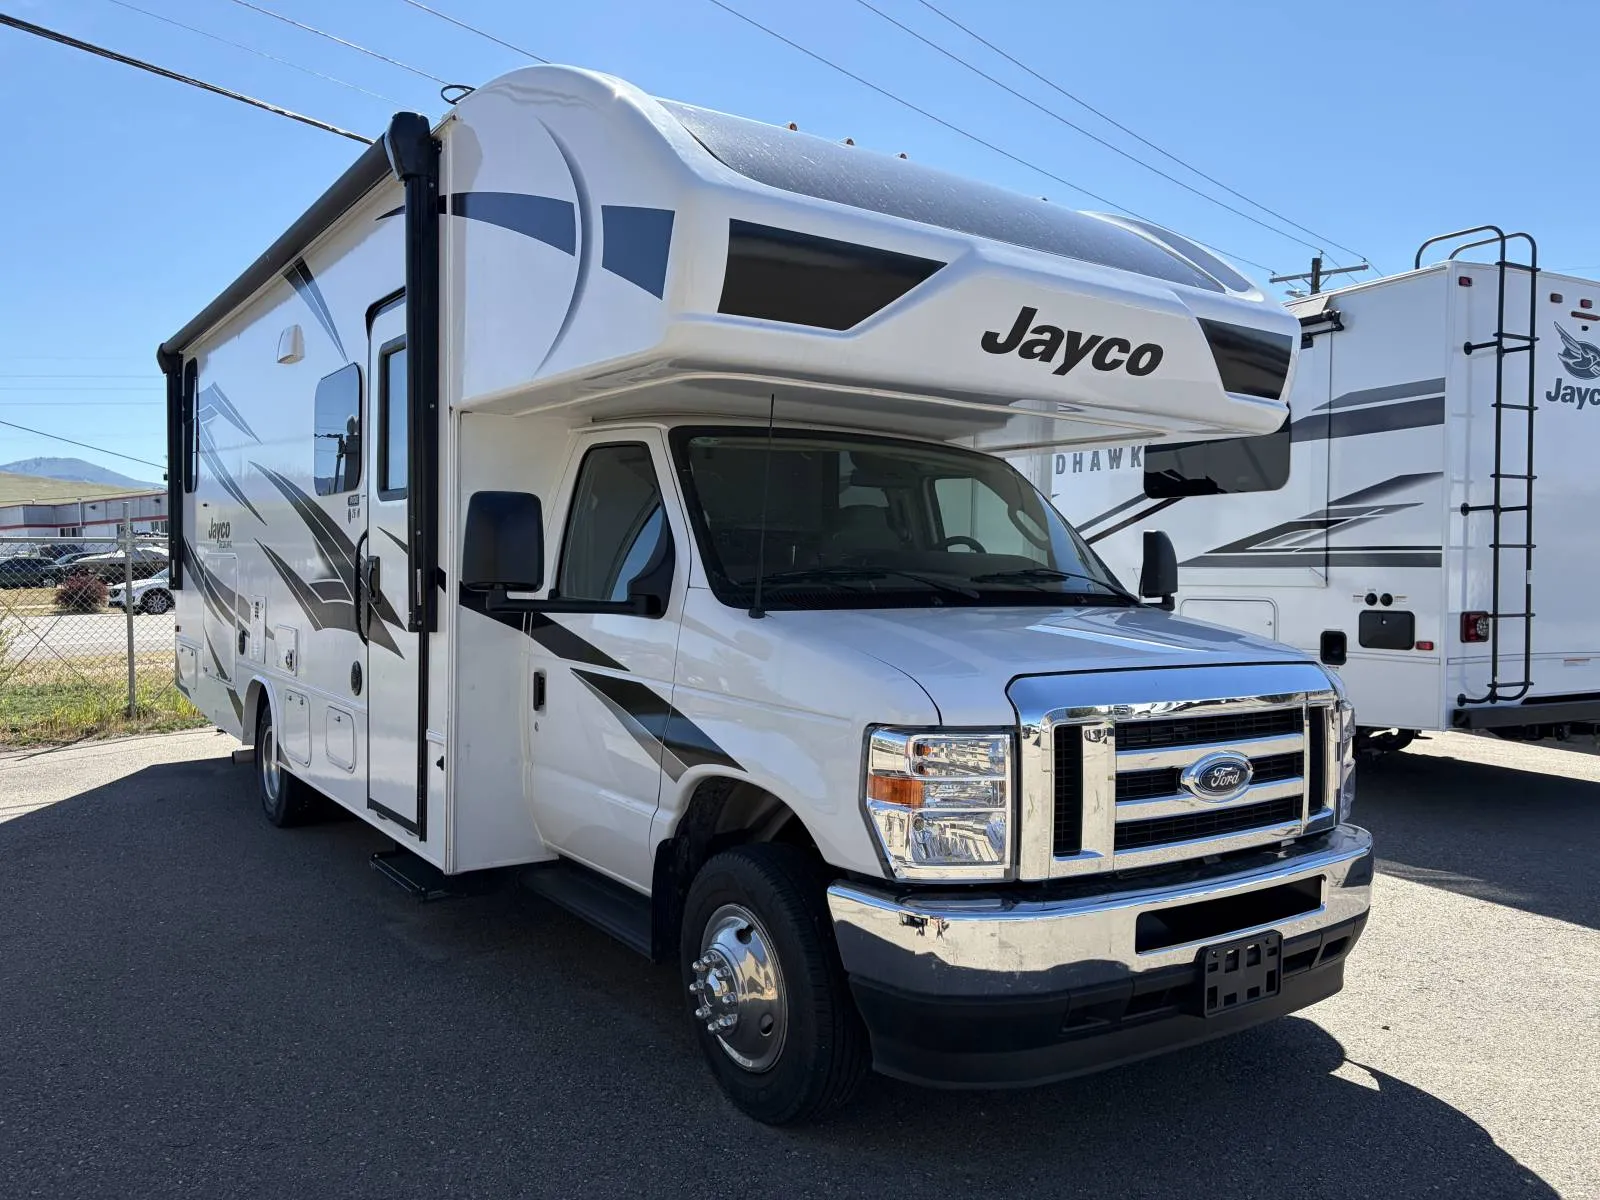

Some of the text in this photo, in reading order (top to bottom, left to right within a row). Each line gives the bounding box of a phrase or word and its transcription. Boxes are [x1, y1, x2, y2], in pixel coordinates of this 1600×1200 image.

[980, 305, 1164, 377] Jayco
[1055, 445, 1142, 475] DHAWK
[208, 516, 231, 543] Jayco
[1210, 766, 1240, 787] Ford
